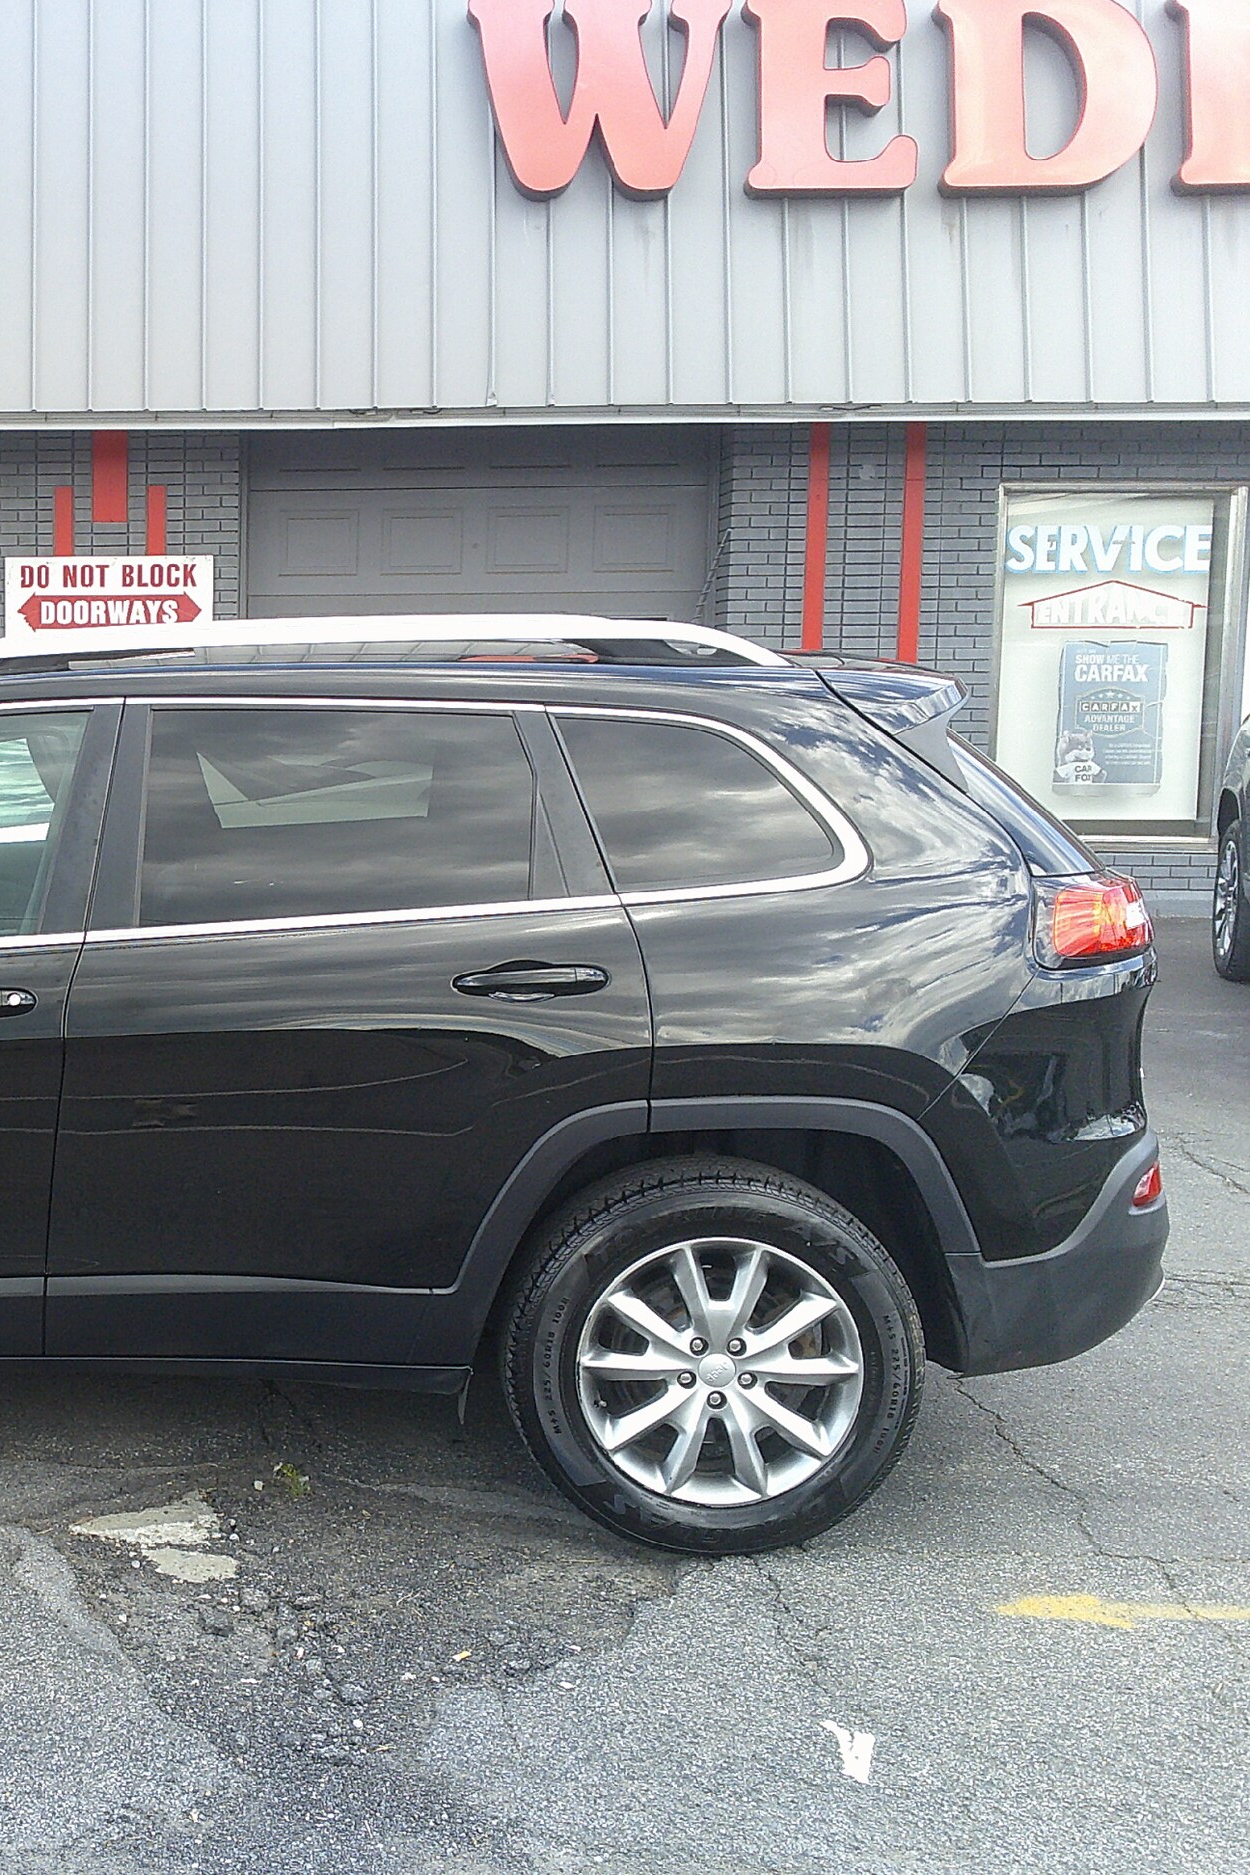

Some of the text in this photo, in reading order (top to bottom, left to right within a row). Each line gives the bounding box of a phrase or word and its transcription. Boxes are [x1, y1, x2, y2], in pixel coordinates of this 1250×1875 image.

[466, 0, 1250, 200] WED
[1006, 524, 1213, 574] SERVICE
[20, 563, 198, 589] DO NOT BLOCK
[40, 600, 179, 625] DOORWAYS
[1075, 654, 1105, 664] SHOW
[1074, 664, 1149, 683] CARFAX
[1081, 702, 1140, 712] CARFAX
[1084, 714, 1135, 724] ADVANTAGE
[1092, 724, 1126, 732] DEALER
[1075, 765, 1092, 773] CAR
